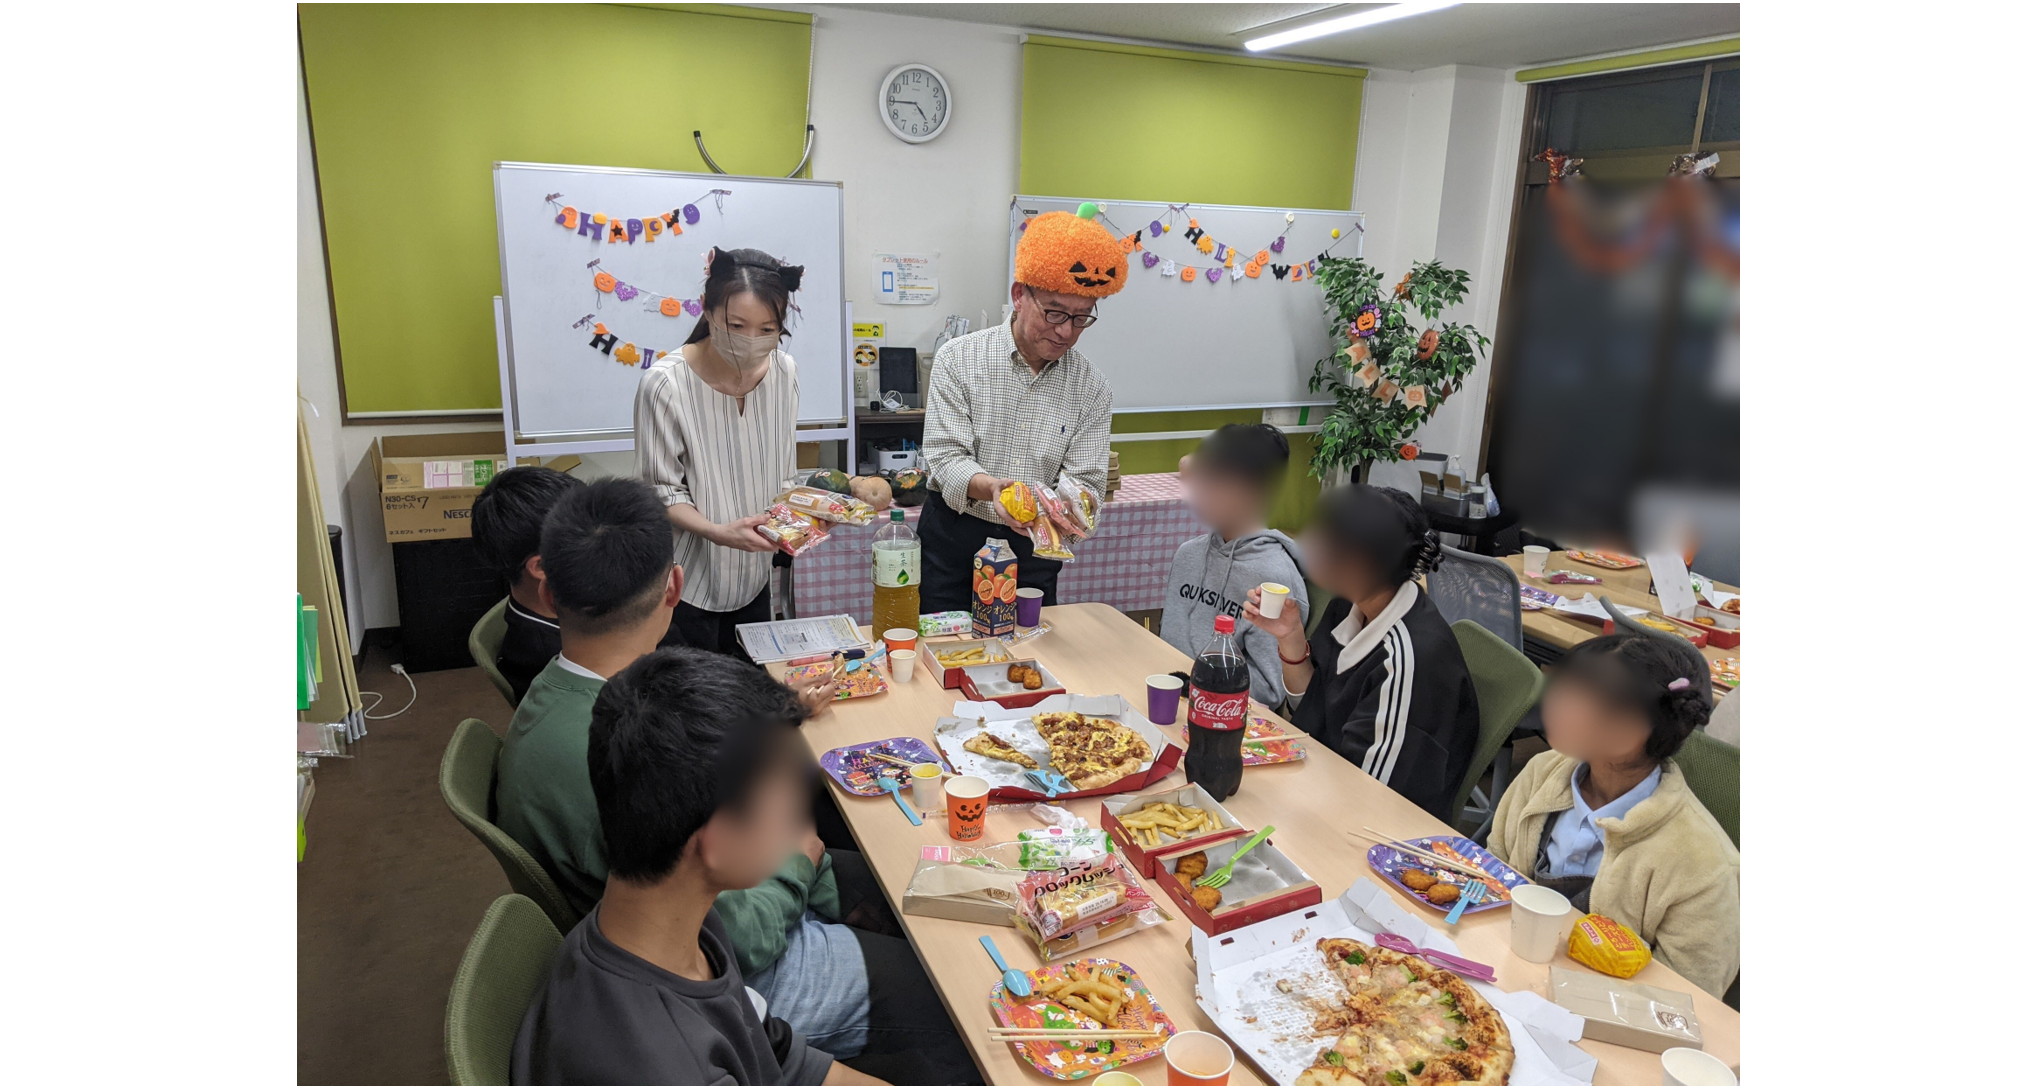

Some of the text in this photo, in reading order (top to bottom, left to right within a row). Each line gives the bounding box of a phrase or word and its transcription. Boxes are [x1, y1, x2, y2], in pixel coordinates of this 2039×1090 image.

[902, 74, 909, 85] 11
[912, 72, 922, 83] 12
[926, 77, 930, 87] 1
[893, 83, 901, 94] 10
[932, 87, 939, 98] 2
[888, 96, 895, 106] 9
[936, 100, 942, 111] 3
[892, 109, 899, 120] 8
[932, 113, 938, 124] 4
[900, 120, 907, 130] 7
[912, 124, 918, 135] 6
[922, 122, 929, 133] 5
[577, 208, 683, 245] HAPPY
[972, 600, 992, 614] オレンジ
[993, 602, 1017, 614] オレンジ
[1056, 861, 1092, 877] コーン
